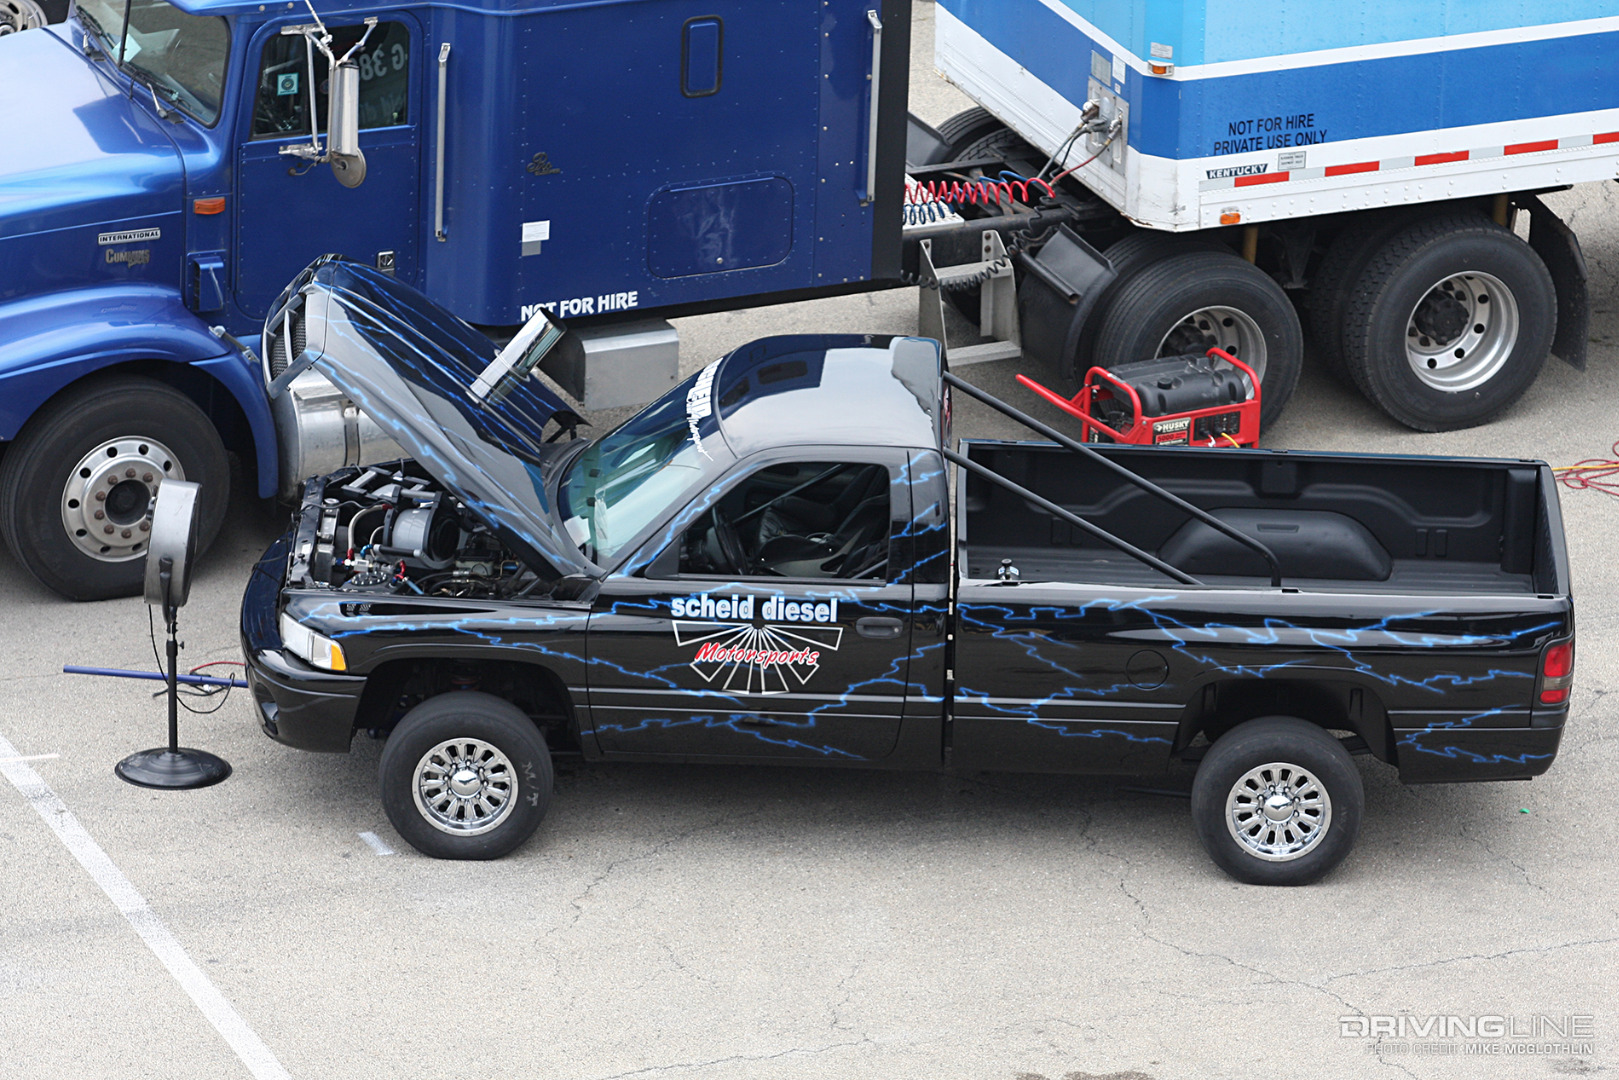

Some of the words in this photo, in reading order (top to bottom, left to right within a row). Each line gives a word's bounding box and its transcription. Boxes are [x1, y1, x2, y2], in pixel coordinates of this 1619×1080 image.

[1228, 120, 1253, 136] NOT
[1257, 117, 1282, 133] FOR
[1286, 113, 1315, 130] HIRE
[1213, 137, 1263, 155] PRIVATE
[1267, 133, 1292, 149] USE
[1295, 129, 1327, 146] ONLY
[1209, 163, 1265, 178] KENTUCKY
[99, 231, 159, 243] INTERNATIONAL
[560, 297, 594, 318] FOR
[598, 291, 638, 313] HIRE
[1163, 420, 1189, 431] HUSKY
[671, 593, 754, 619] scheid
[762, 595, 838, 622] diesel
[694, 642, 820, 669] Motorsports
